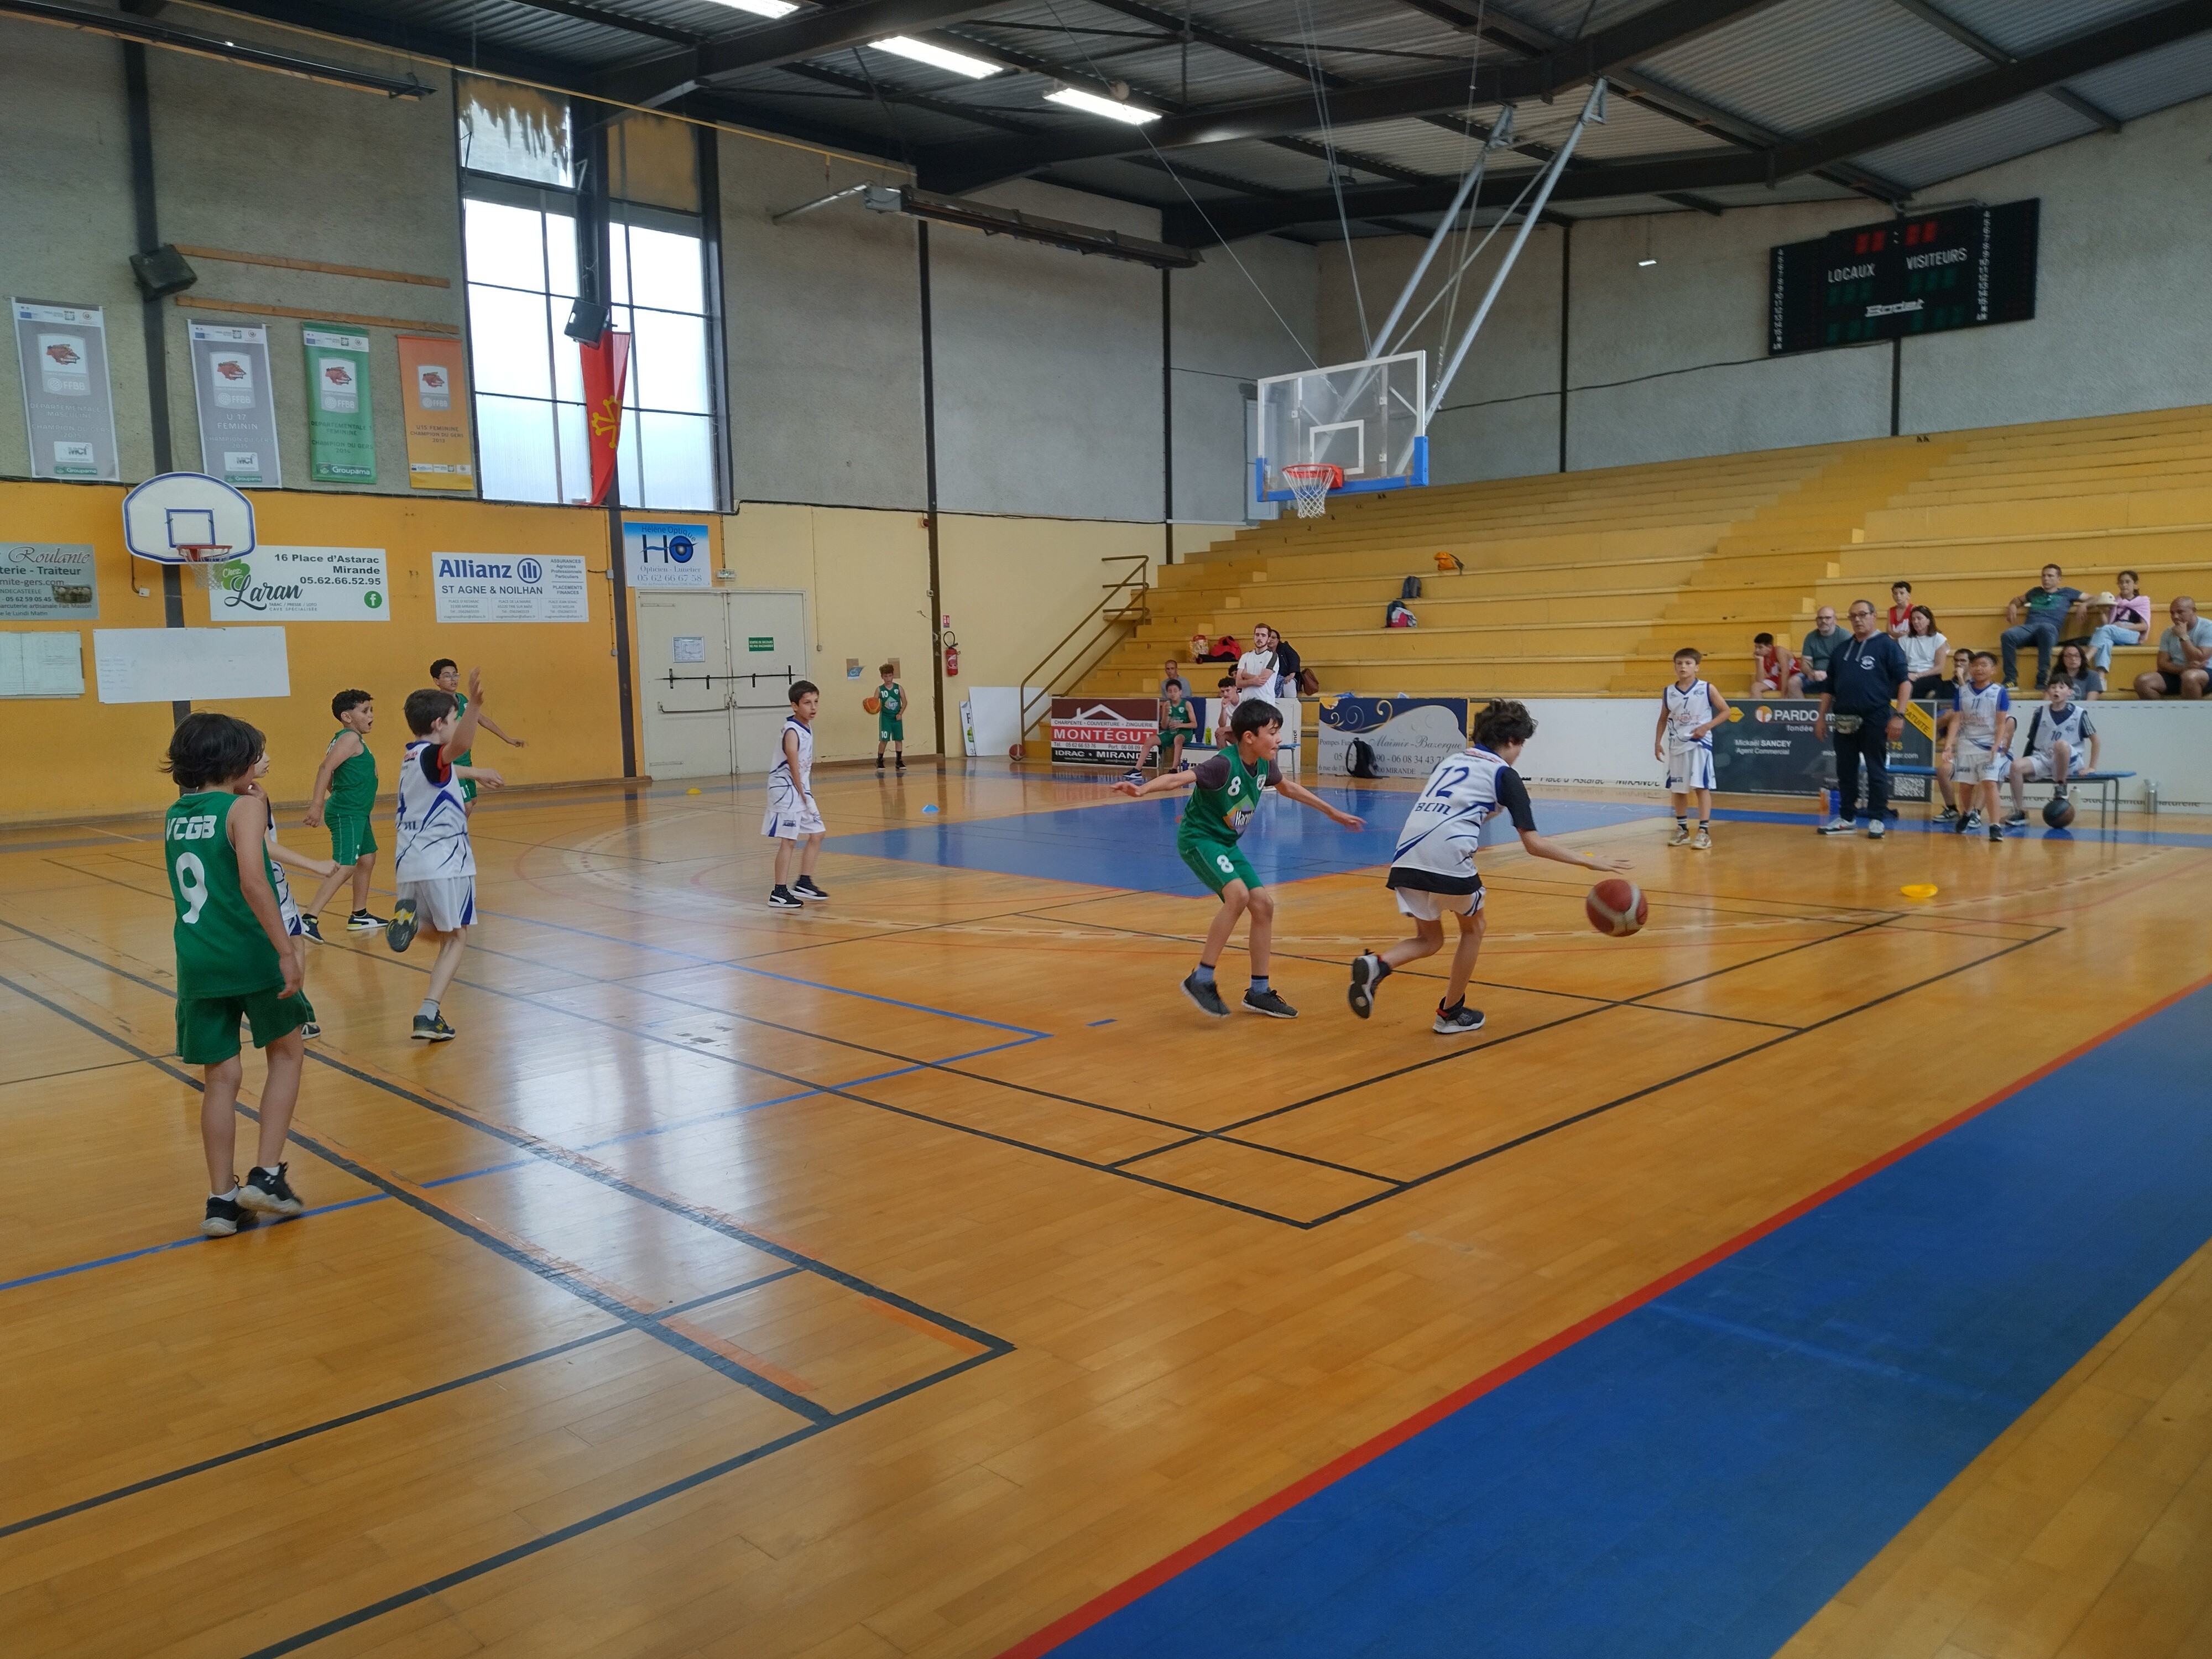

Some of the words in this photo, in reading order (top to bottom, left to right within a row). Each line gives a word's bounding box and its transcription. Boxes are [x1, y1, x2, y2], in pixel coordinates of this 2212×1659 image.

[1906, 247, 1968, 270] VISITEURS
[1827, 262, 1876, 283] LOCAUX
[64, 380, 85, 390] FFBB
[232, 395, 251, 404] FFBB
[337, 399, 355, 409] FFBB
[432, 399, 448, 408] FFBB
[30, 403, 100, 413] DEPARTEMENTALE
[311, 421, 367, 430] DEPARTEMENTALE
[332, 466, 371, 475] Groupama
[667, 526, 696, 542] Optique
[8, 546, 90, 564] Roulante
[274, 554, 289, 562] 16
[293, 554, 324, 562] Place
[327, 555, 379, 564] d'Astarac
[36, 566, 82, 575] Traiteur
[222, 567, 242, 578] Chez
[333, 565, 380, 575] Mirande
[439, 559, 512, 578] Allianz
[640, 565, 667, 573] Opticien
[300, 576, 381, 585] 05.62.66.52.95
[224, 574, 304, 611] Laran
[442, 586, 455, 594] ST
[458, 586, 487, 594] AGNE
[499, 586, 543, 594] NOILHAN
[1683, 697, 1689, 709] 7
[1971, 697, 1981, 710] 11
[1906, 708, 1931, 733] ATUITE
[1053, 728, 1154, 742] MONTÉGUT
[2051, 731, 2062, 741] 10
[1334, 753, 1343, 761] 05
[1403, 755, 1412, 763] 08
[1415, 755, 1423, 764] 34
[1227, 775, 1241, 796] 8
[1426, 765, 1470, 799] 12
[1217, 854, 1234, 873] 8
[175, 852, 208, 924] 9
